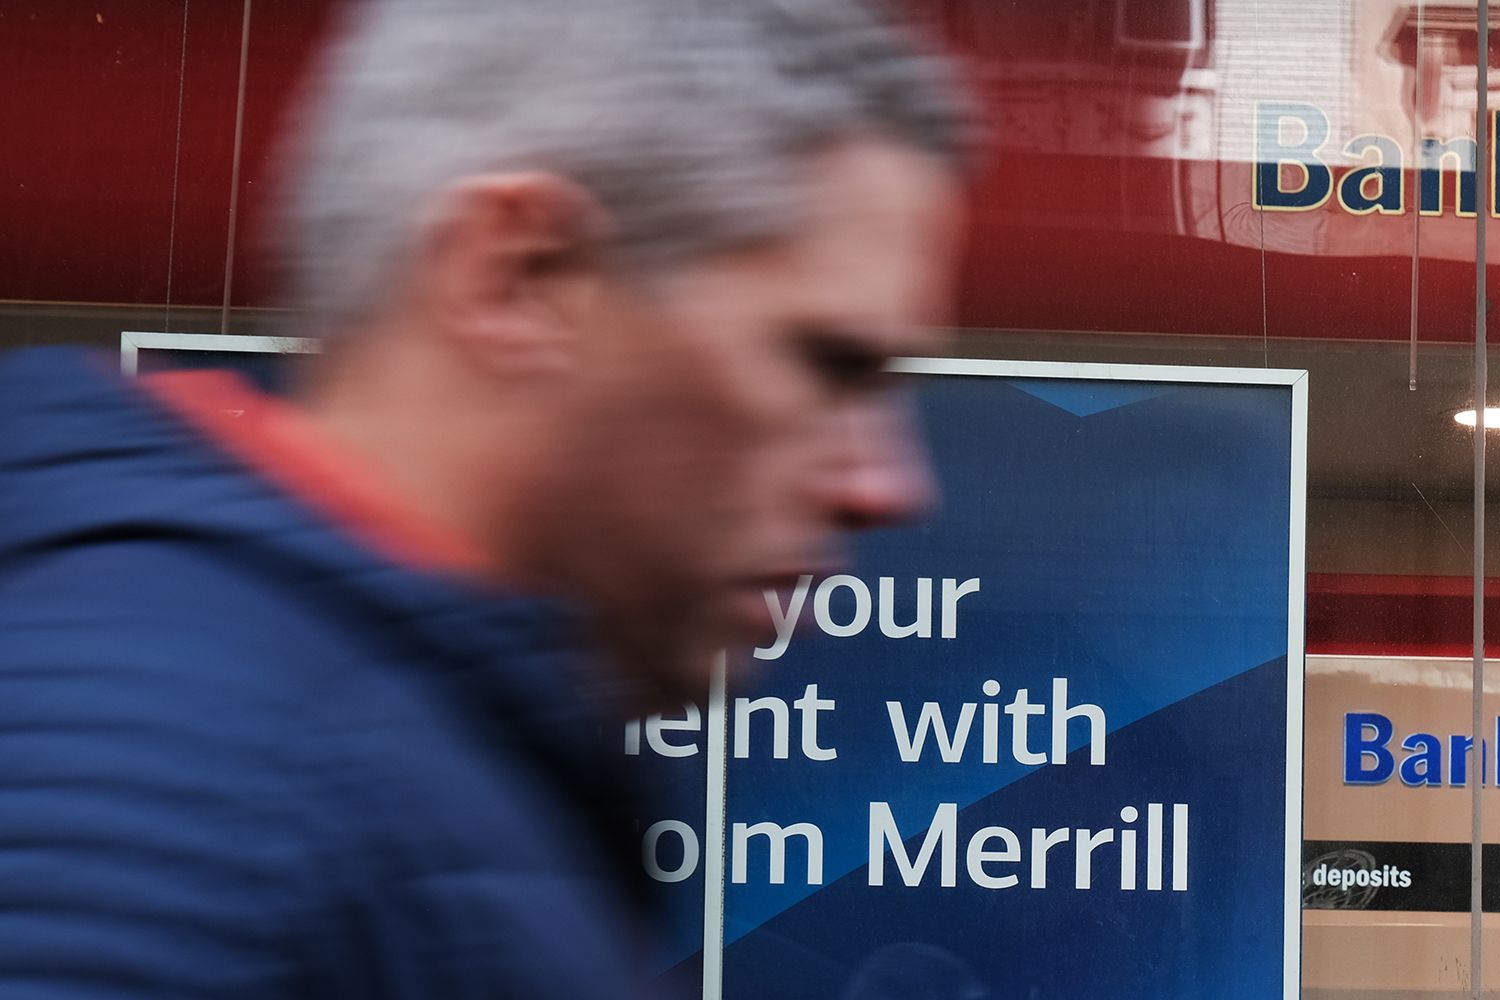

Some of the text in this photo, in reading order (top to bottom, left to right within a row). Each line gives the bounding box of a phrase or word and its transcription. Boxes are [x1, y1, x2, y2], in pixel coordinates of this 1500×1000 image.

[753, 574, 980, 660] your
[886, 678, 1107, 766] with
[867, 801, 1189, 891] Merrill
[1313, 864, 1412, 891] deposits
